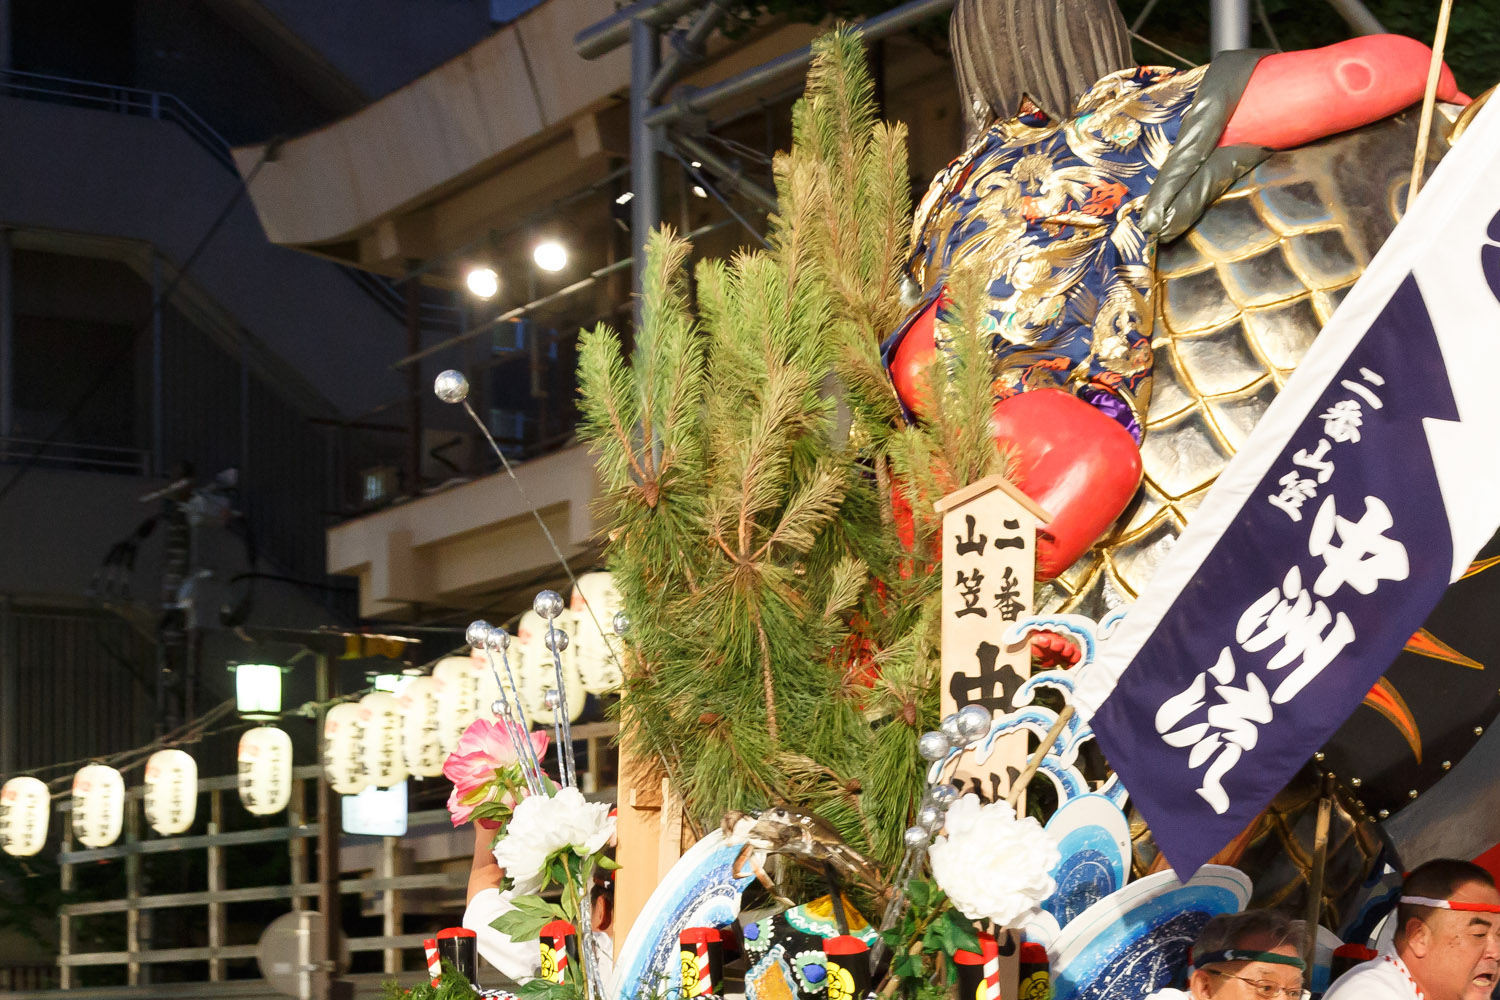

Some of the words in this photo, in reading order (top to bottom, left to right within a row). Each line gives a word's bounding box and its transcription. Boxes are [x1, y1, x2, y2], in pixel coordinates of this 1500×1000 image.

[1268, 367, 1385, 522] 二番山笠
[955, 514, 988, 619] 山笠
[994, 518, 1026, 622] 二番
[1156, 494, 1410, 815] 中洲流
